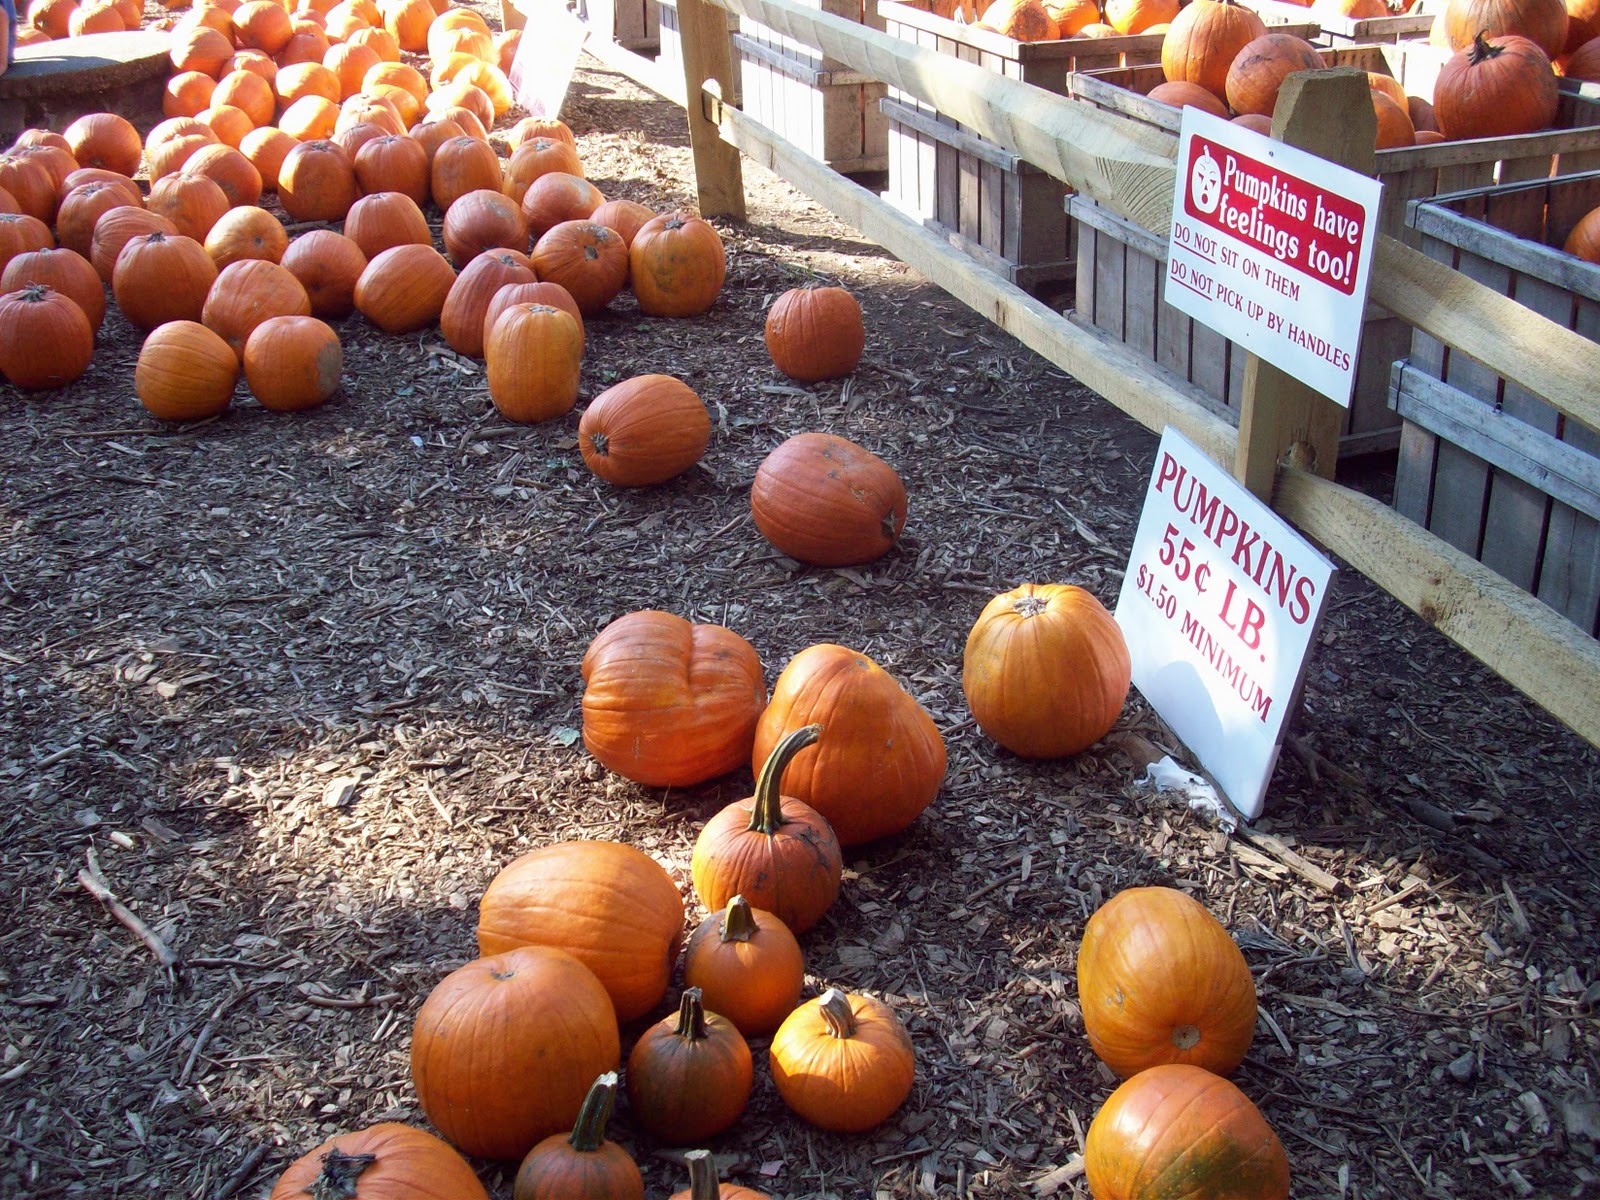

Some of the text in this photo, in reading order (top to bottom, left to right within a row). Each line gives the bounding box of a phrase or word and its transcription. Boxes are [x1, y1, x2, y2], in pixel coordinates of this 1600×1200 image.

[1218, 193, 1354, 285] feelings too!
[1223, 155, 1359, 244] Pumpkins have
[1171, 258, 1351, 371] DO NOT PICK UP BY HANDLES
[1174, 222, 1300, 301] DO NOT SIT ON THEM
[1155, 451, 1315, 625] PUMPKINS
[1159, 522, 1266, 663] 55¢ LB.
[1136, 563, 1273, 723] $1.50 MINIMUM
